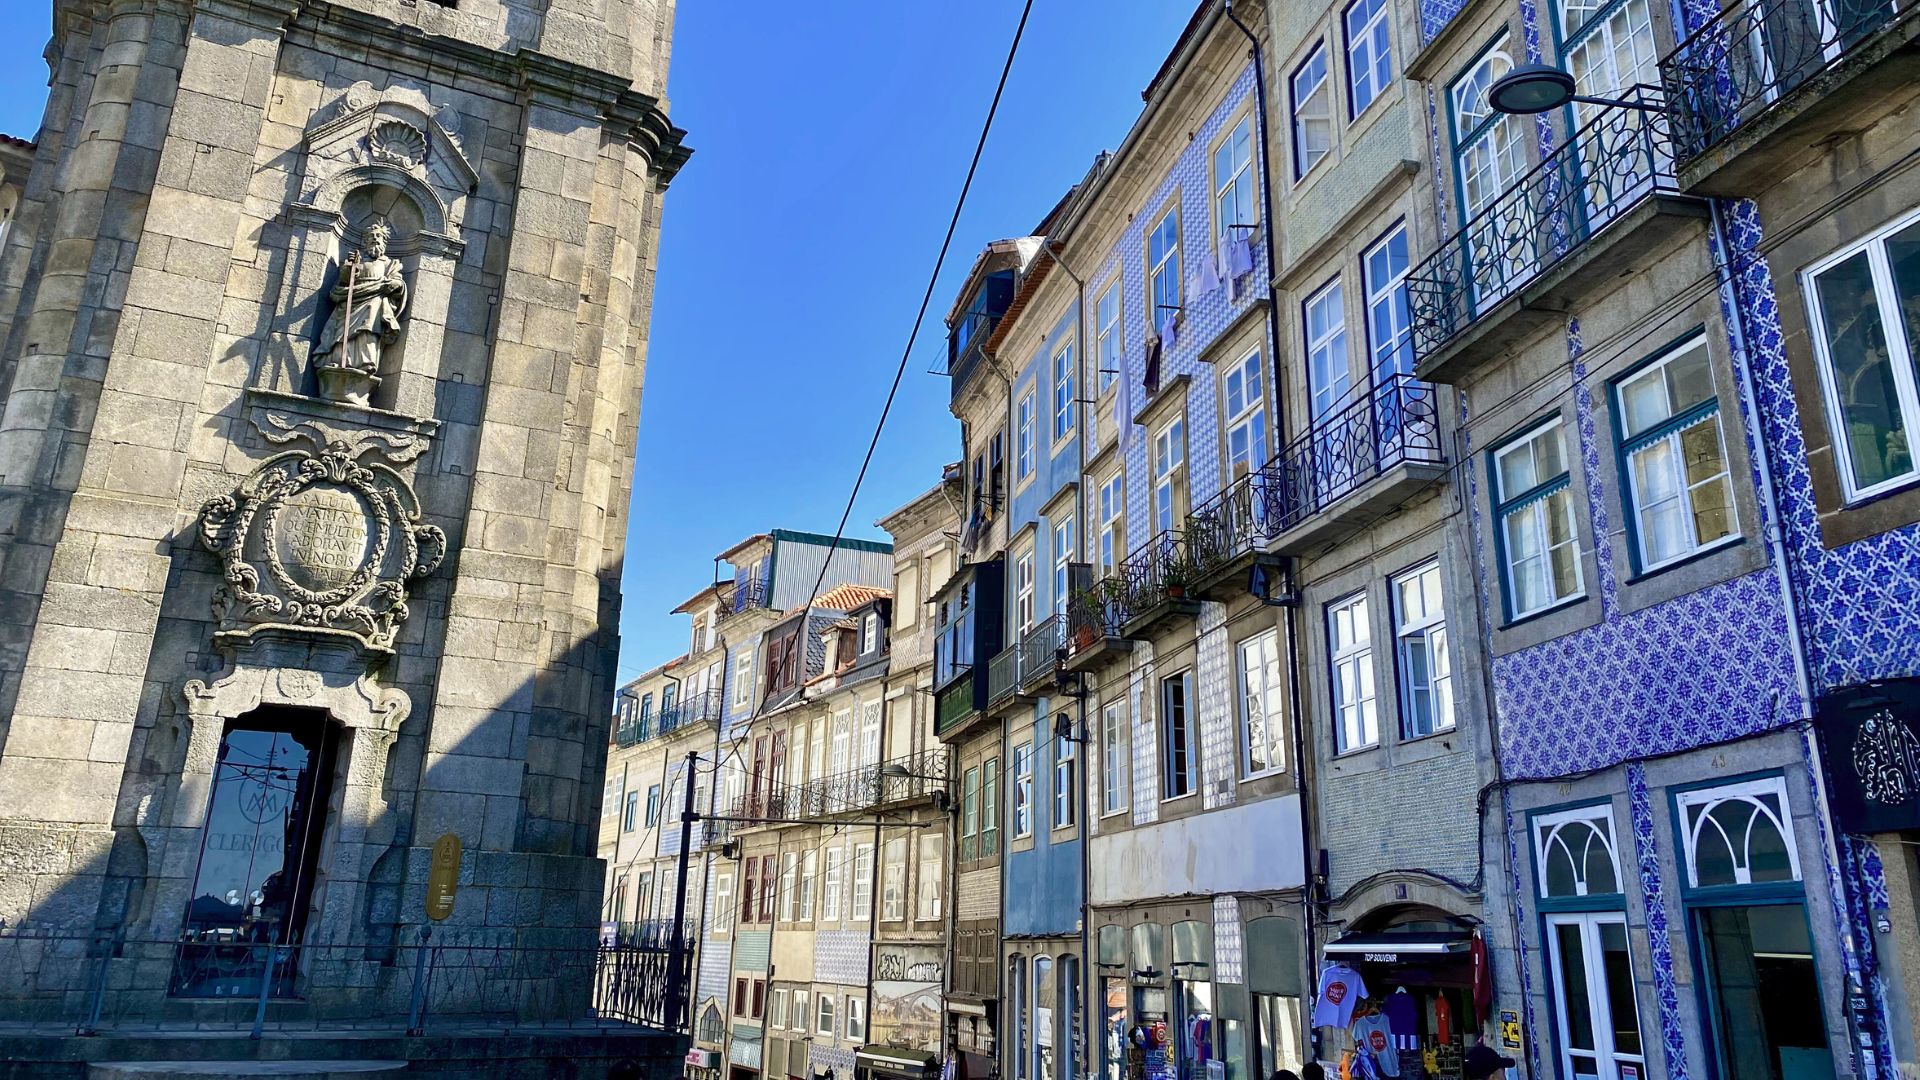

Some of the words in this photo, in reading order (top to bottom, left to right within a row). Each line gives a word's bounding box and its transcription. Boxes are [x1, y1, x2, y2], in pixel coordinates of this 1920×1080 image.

[284, 533, 363, 554] LABORAVIT
[313, 551, 354, 567] NOBIS
[1365, 953, 1373, 962] TOP
[1374, 953, 1397, 963] SOUVENIR
